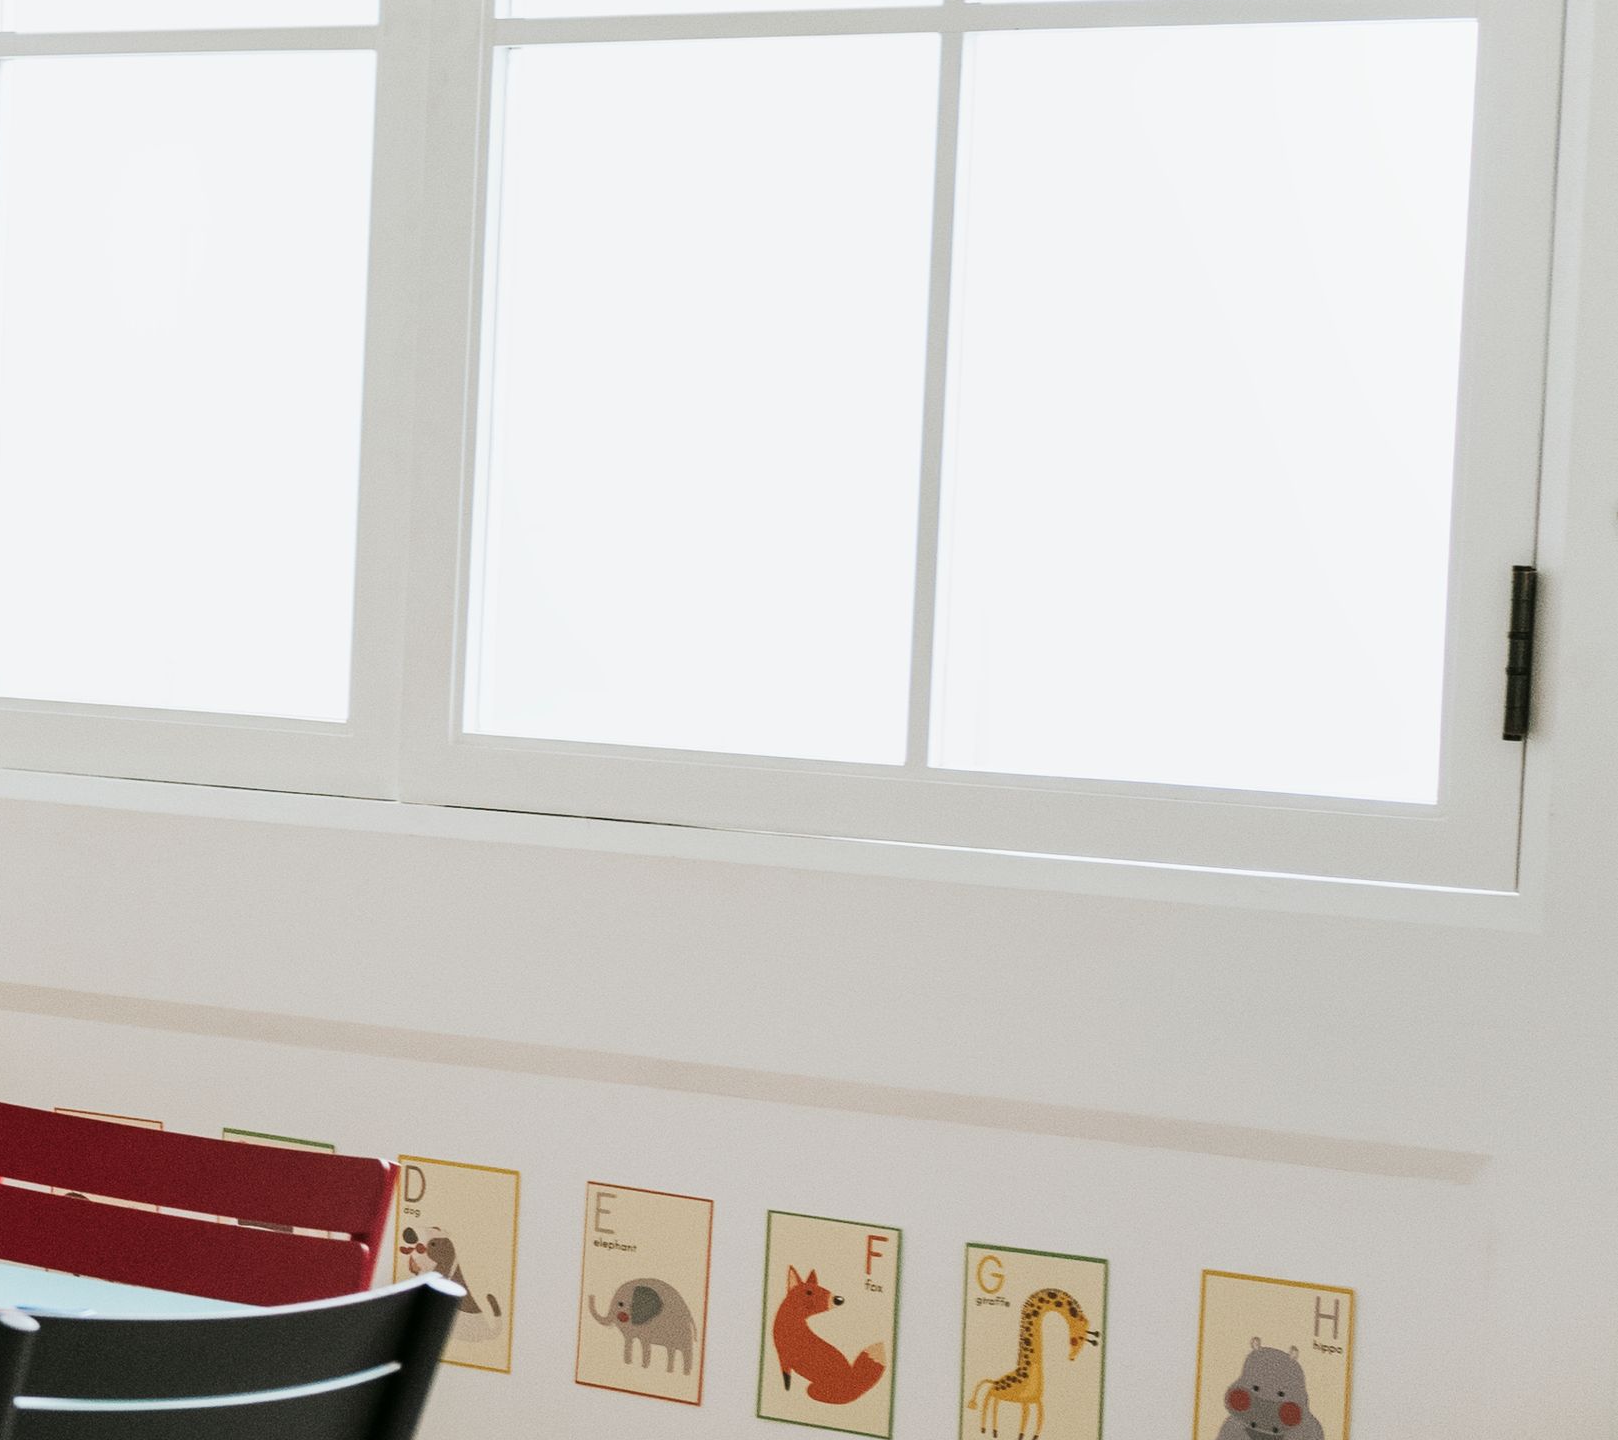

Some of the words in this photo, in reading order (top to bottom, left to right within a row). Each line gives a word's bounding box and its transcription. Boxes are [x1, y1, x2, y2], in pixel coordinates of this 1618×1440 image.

[404, 1165, 426, 1203] D
[403, 1206, 421, 1219] dog
[595, 1191, 617, 1235] E
[593, 1237, 637, 1254] elephant
[865, 1234, 889, 1276] F
[865, 1279, 884, 1293] fox
[976, 1255, 1005, 1294] G
[976, 1296, 1011, 1307] giraffe
[1314, 1295, 1340, 1340] H
[1313, 1339, 1343, 1355] hippo
